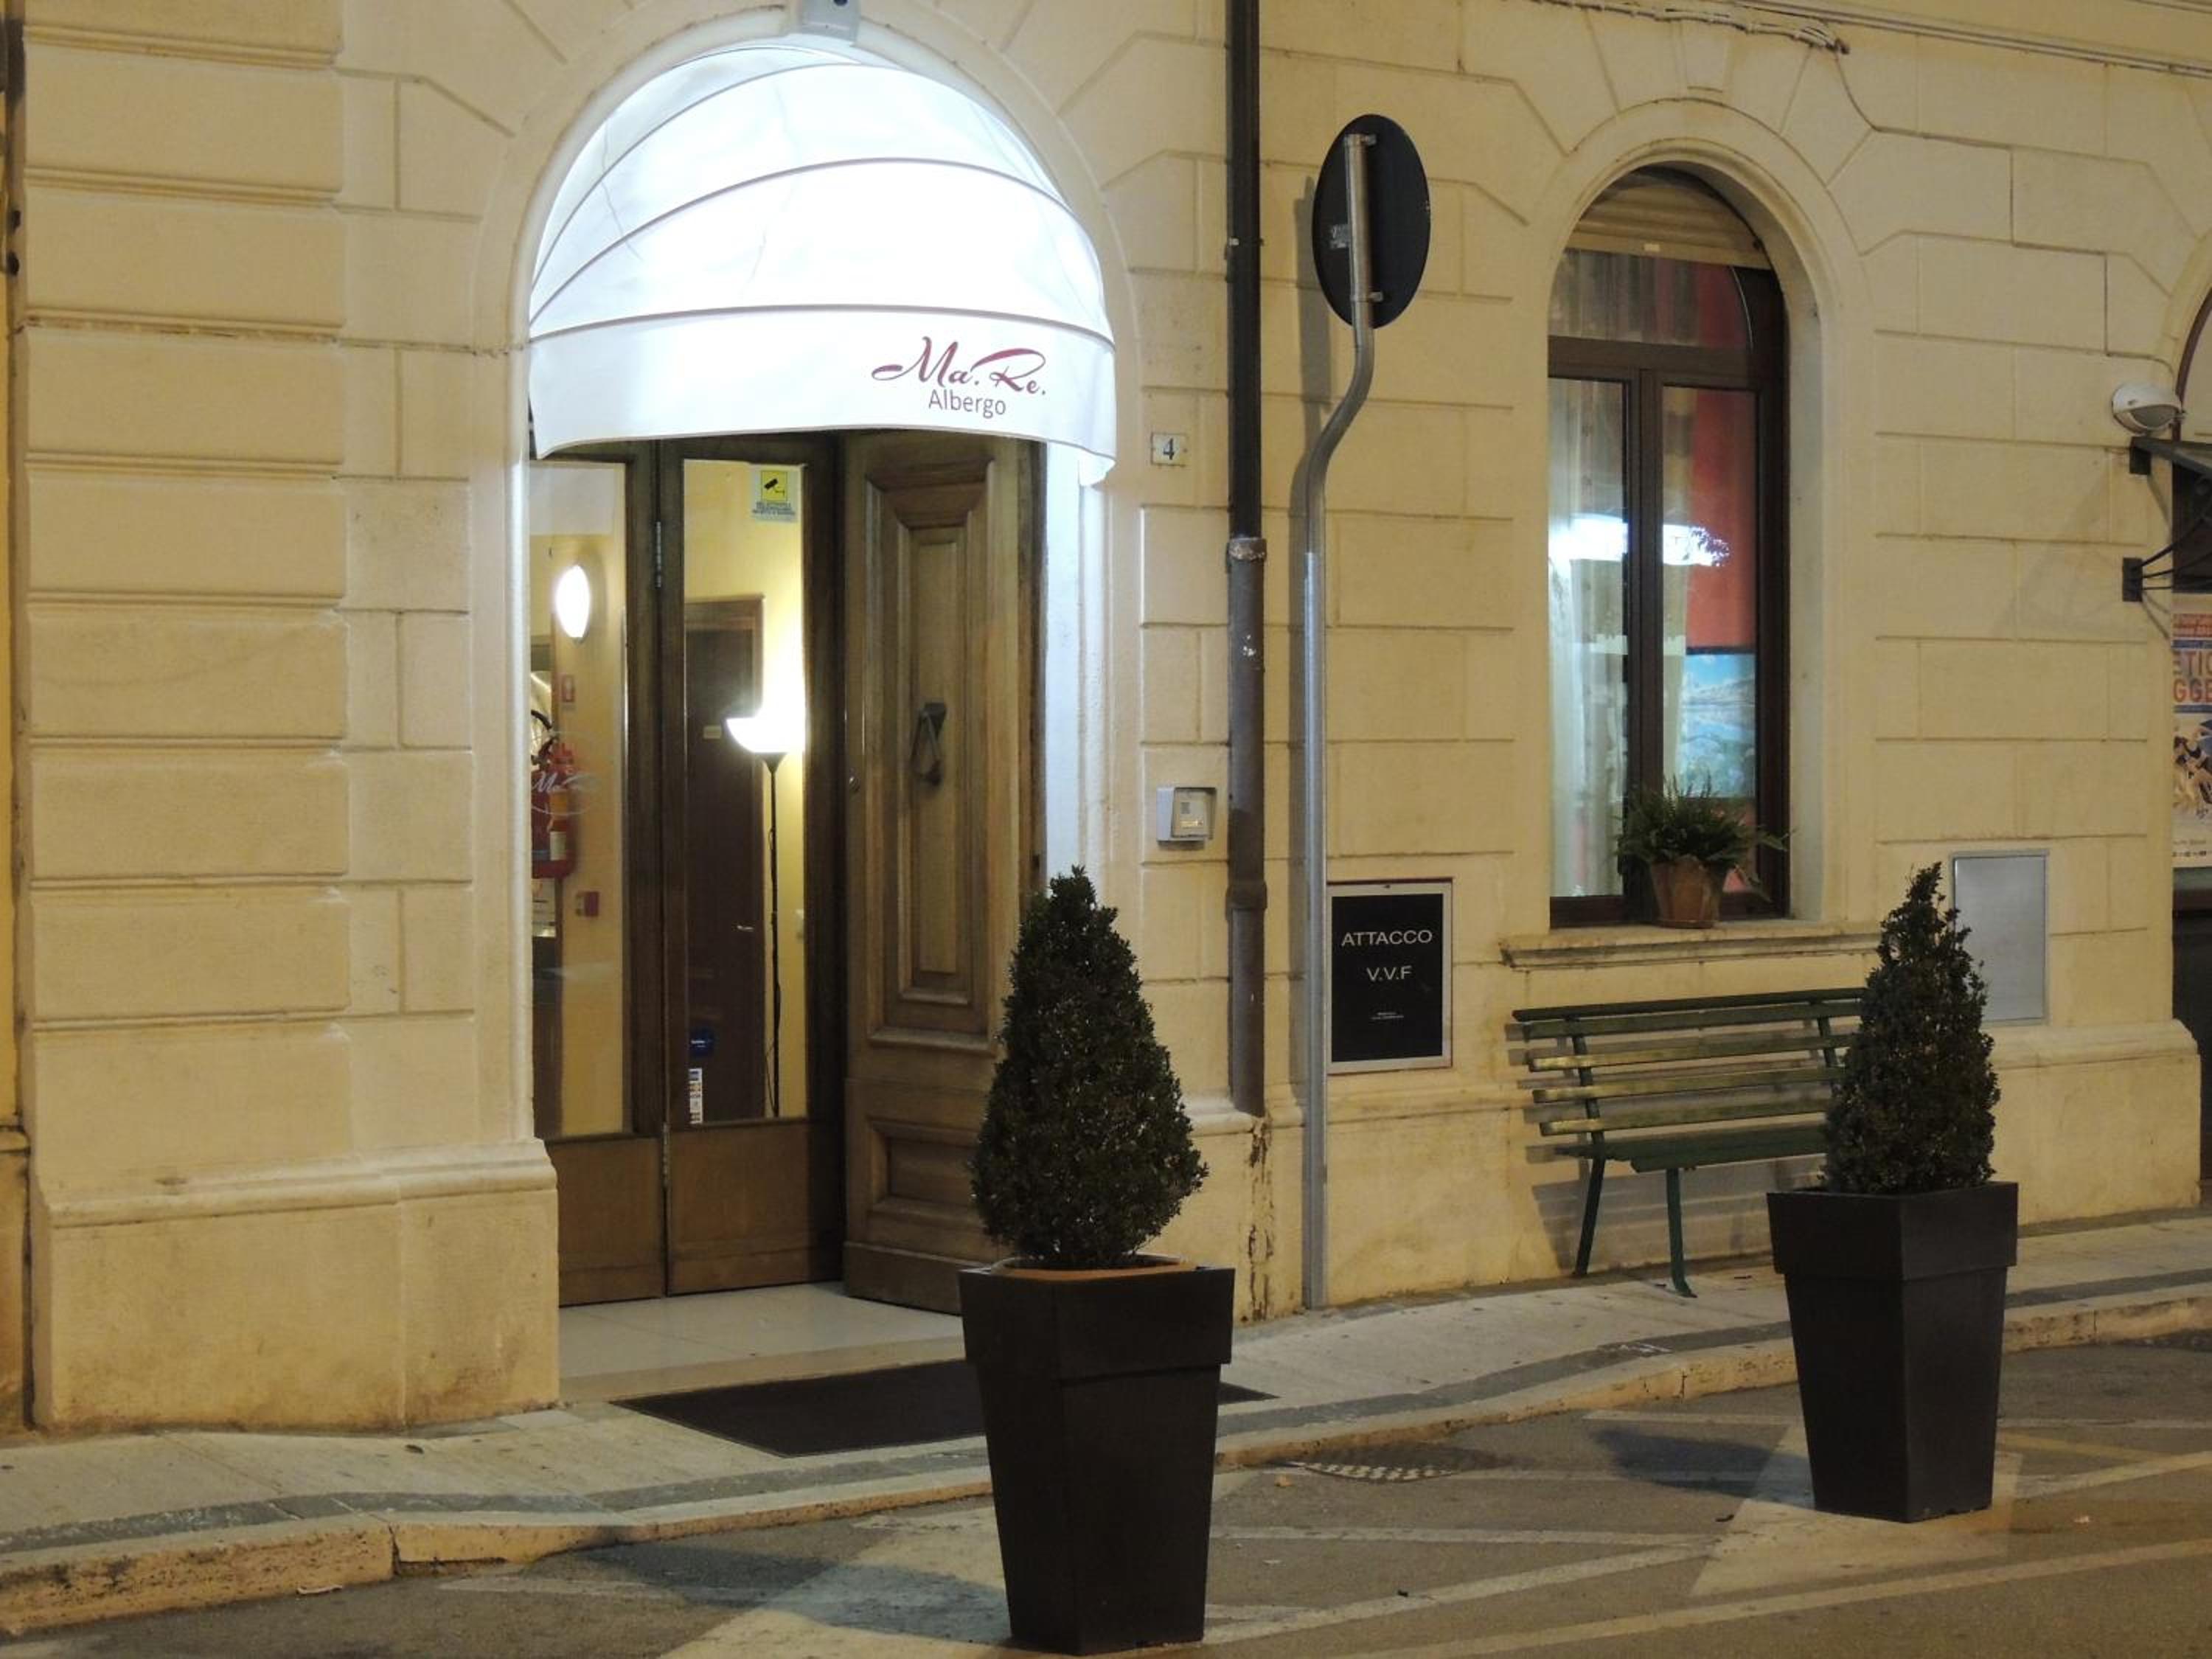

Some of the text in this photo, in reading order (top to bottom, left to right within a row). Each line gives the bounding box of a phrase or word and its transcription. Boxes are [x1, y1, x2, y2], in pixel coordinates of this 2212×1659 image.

[928, 388, 1006, 419] Albergo
[1163, 437, 1175, 461] 4
[1341, 930, 1433, 947] ATTACCO
